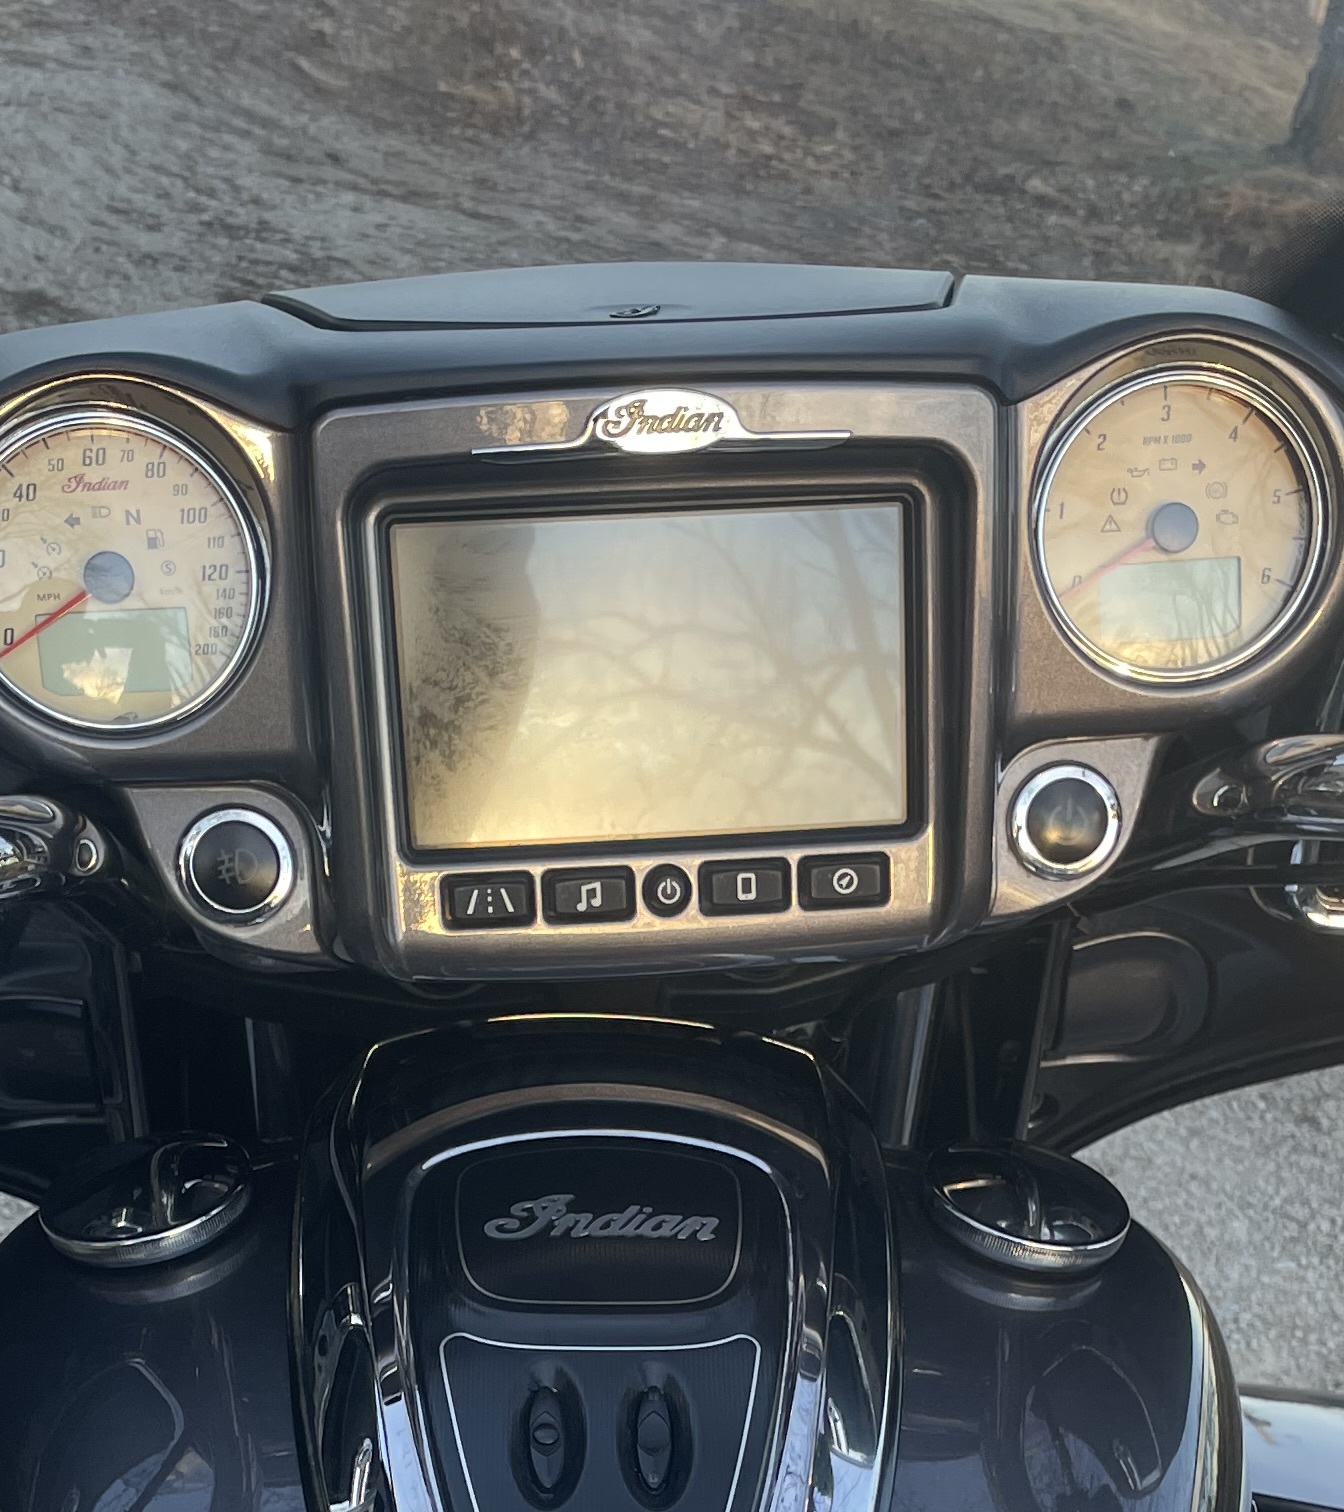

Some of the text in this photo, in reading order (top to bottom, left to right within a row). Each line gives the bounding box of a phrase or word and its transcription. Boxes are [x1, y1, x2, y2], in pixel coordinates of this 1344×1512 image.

[602, 399, 724, 438] Indian
[1160, 404, 1171, 422] 3
[1096, 433, 1107, 451] 2
[1228, 426, 1238, 442] 4
[47, 458, 64, 472] 50
[82, 447, 106, 467] 60
[120, 449, 134, 463] 70
[145, 461, 166, 479] 80
[13, 483, 37, 502] 40
[61, 473, 129, 494] Indian
[172, 483, 188, 496] 90
[1272, 489, 1281, 505] 5
[124, 509, 142, 526] N
[179, 507, 208, 525] 100
[1059, 501, 1065, 519] 1
[207, 536, 225, 549] 110
[201, 564, 229, 582] 120
[1261, 567, 1272, 585] 6
[37, 592, 61, 602] MPH
[216, 588, 235, 600] 140
[3, 627, 14, 646] 0
[194, 643, 218, 656] 200
[484, 1194, 720, 1241] Indian
